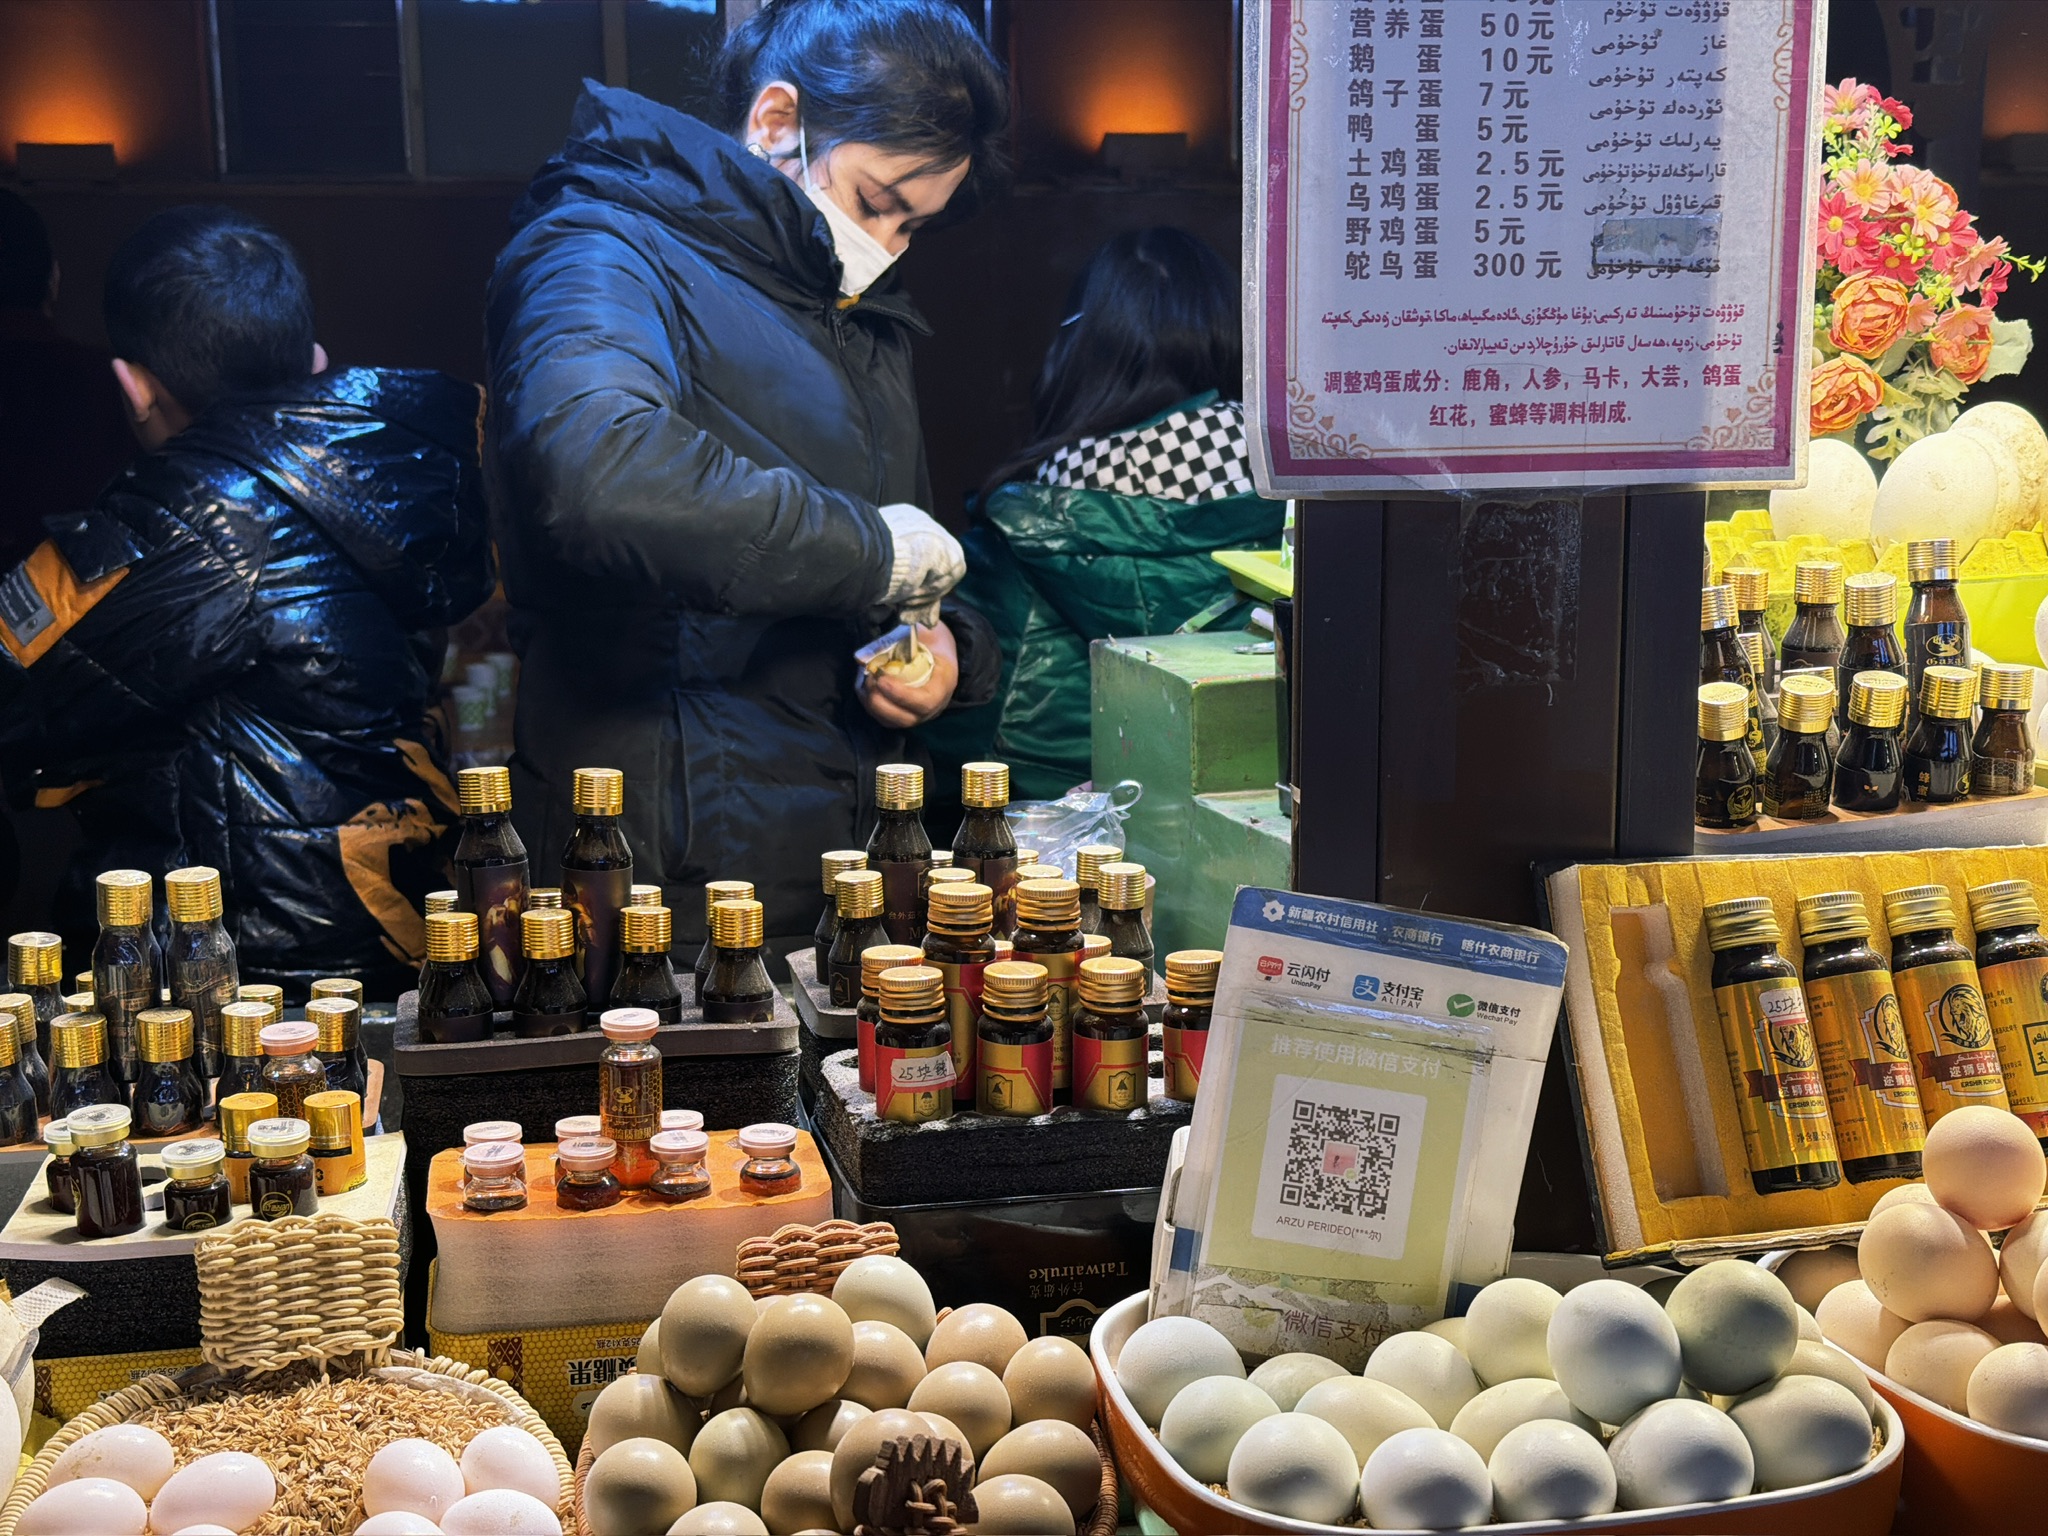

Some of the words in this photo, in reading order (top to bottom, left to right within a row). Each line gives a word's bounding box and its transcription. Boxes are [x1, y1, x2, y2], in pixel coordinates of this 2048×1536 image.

[1350, 8, 1445, 39] 营养蛋
[1480, 12, 1555, 40] 50元
[1699, 34, 1728, 56] غاز
[1481, 46, 1554, 75] 10元
[1588, 66, 1655, 88] تۇخۇمى
[1347, 78, 1443, 109] 鸽子蛋
[1479, 81, 1530, 110] 7元
[1589, 98, 1655, 121] تۇخۇمى
[1477, 115, 1529, 144] 5元
[1586, 131, 1652, 153] تۇخۇمى
[1346, 148, 1441, 178] 土鸡蛋
[1476, 149, 1565, 178] 2.5元
[1346, 181, 1441, 212] 乌鸡蛋
[1475, 183, 1564, 212] 2.5元
[1345, 216, 1440, 246] 野鸡蛋
[1474, 217, 1526, 246] 5元
[1344, 250, 1439, 280] 鸵鸟蛋
[1473, 251, 1562, 280] 300元
[1461, 938, 1540, 965] 喀什农商银行
[1287, 962, 1331, 983] 云闪付
[1291, 978, 1322, 990] UnionPay
[1381, 981, 1424, 1001] 支付宝
[1381, 995, 1421, 1009] ALIPAY
[1476, 1000, 1521, 1018] 微信支付
[1476, 1012, 1503, 1023] Wechat
[1503, 1016, 1518, 1026] Pay
[1271, 1033, 1441, 1079] 推荐使用微信支付
[1276, 1215, 1305, 1228] ARZU
[1028, 1260, 1129, 1281] Taiwairuke
[1284, 1309, 1390, 1347] 微信支付
